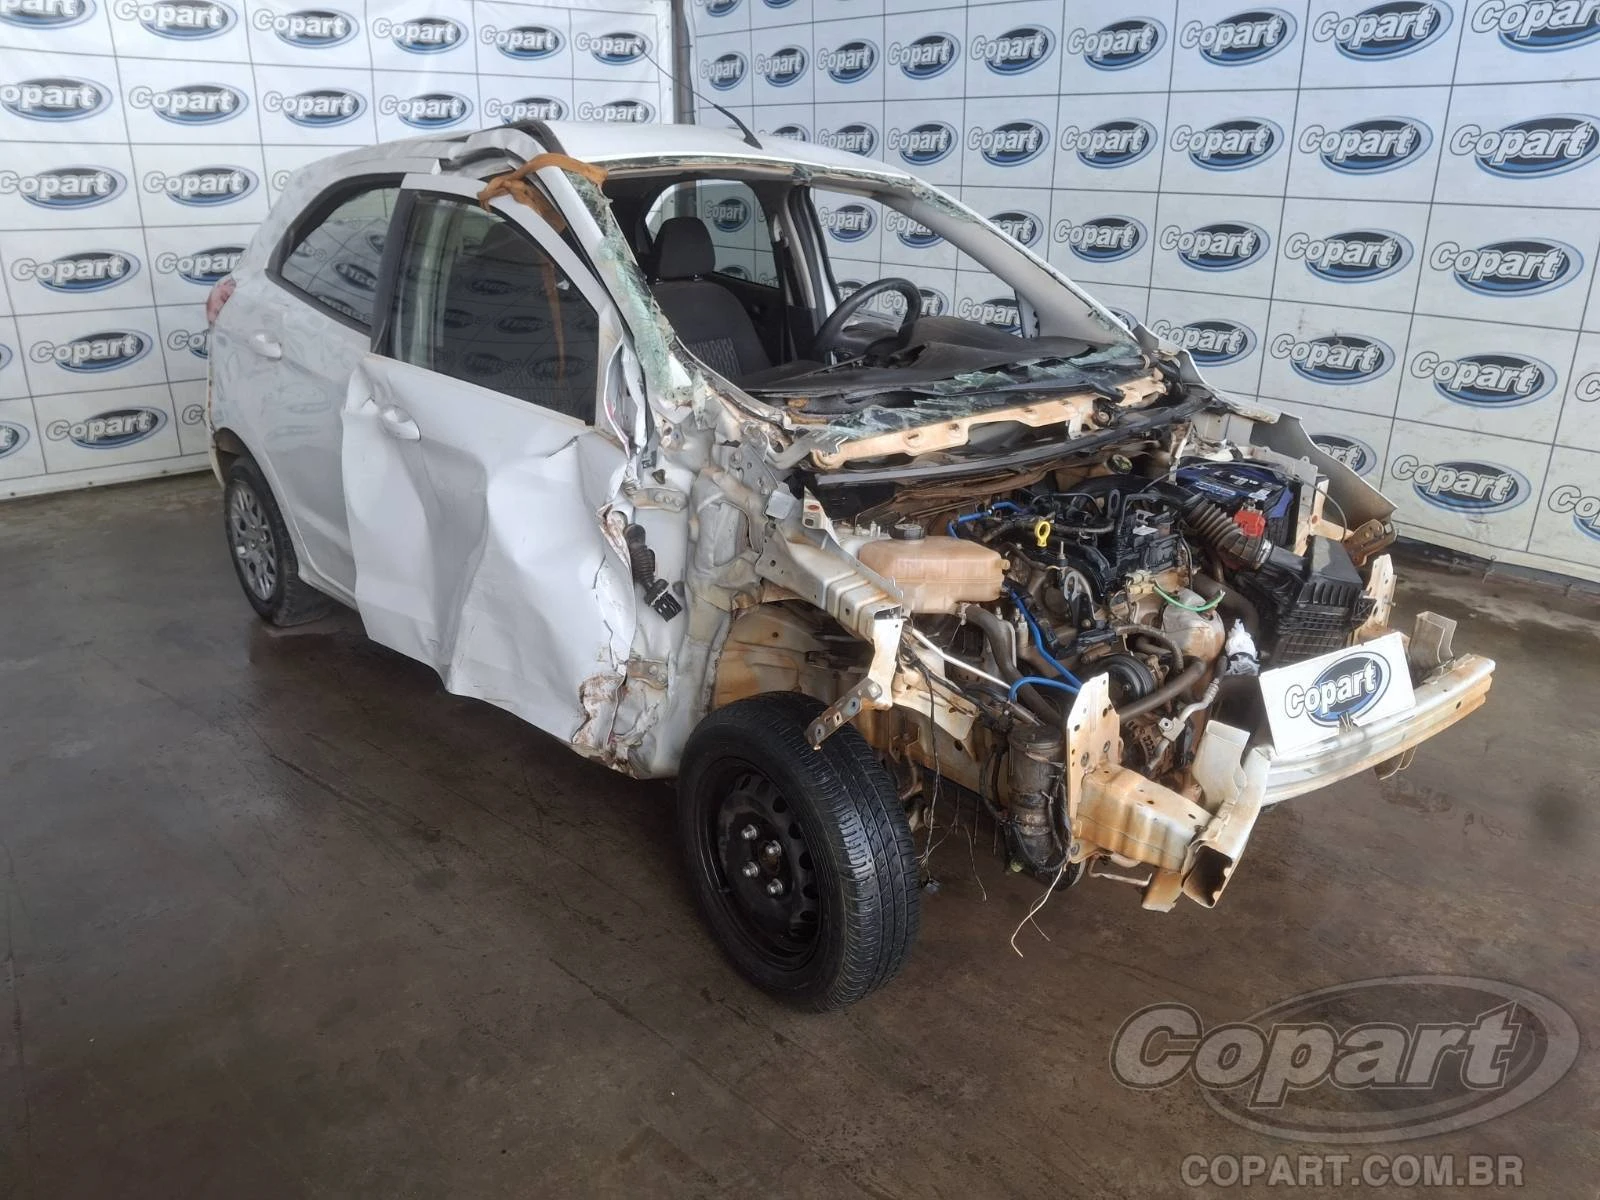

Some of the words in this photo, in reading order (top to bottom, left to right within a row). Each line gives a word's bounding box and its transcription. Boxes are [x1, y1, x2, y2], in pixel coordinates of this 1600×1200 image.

[114, 0, 221, 28] Copart
[252, 8, 345, 37] Copart
[1313, 3, 1438, 49] Copart
[1471, 0, 1600, 40] Copar
[372, 17, 457, 45] Copart
[480, 25, 556, 50] Copart
[574, 32, 643, 57] Copart
[1067, 24, 1156, 61] Copart
[1180, 15, 1284, 56] Copart
[817, 45, 870, 76] Copart
[888, 39, 951, 71] Copart
[970, 31, 1046, 66] Copart
[700, 55, 742, 83] Copart
[755, 51, 803, 80] Copart
[129, 86, 235, 115] Copart
[263, 91, 356, 118] Copart
[379, 94, 463, 119] Copart
[484, 98, 559, 122] Copart
[578, 102, 645, 121] Copart
[818, 127, 870, 150] Copart
[887, 127, 949, 156] Copart
[968, 126, 1041, 157] Copart
[1061, 125, 1149, 158] Copart
[1170, 123, 1271, 159] Copart
[1299, 122, 1419, 161] Copart
[1450, 122, 1594, 165] Copart
[0, 170, 112, 200] Copart
[143, 170, 244, 198] Copart
[704, 200, 745, 222] Copart
[819, 206, 869, 233] Copart
[884, 210, 932, 238] Copa
[1053, 219, 1136, 251] Copart
[1160, 225, 1256, 260] Copart
[1285, 232, 1398, 270] Copart
[1430, 241, 1564, 281] Copart
[11, 254, 125, 286] Copart
[959, 298, 1020, 327] Copar
[29, 335, 139, 366] Copart
[1151, 319, 1243, 354] Copart
[1271, 333, 1381, 373] Copart
[1411, 351, 1540, 395] Copart
[46, 411, 153, 441] Copart
[1391, 455, 1515, 502] Copart
[1285, 659, 1378, 718] Copart
